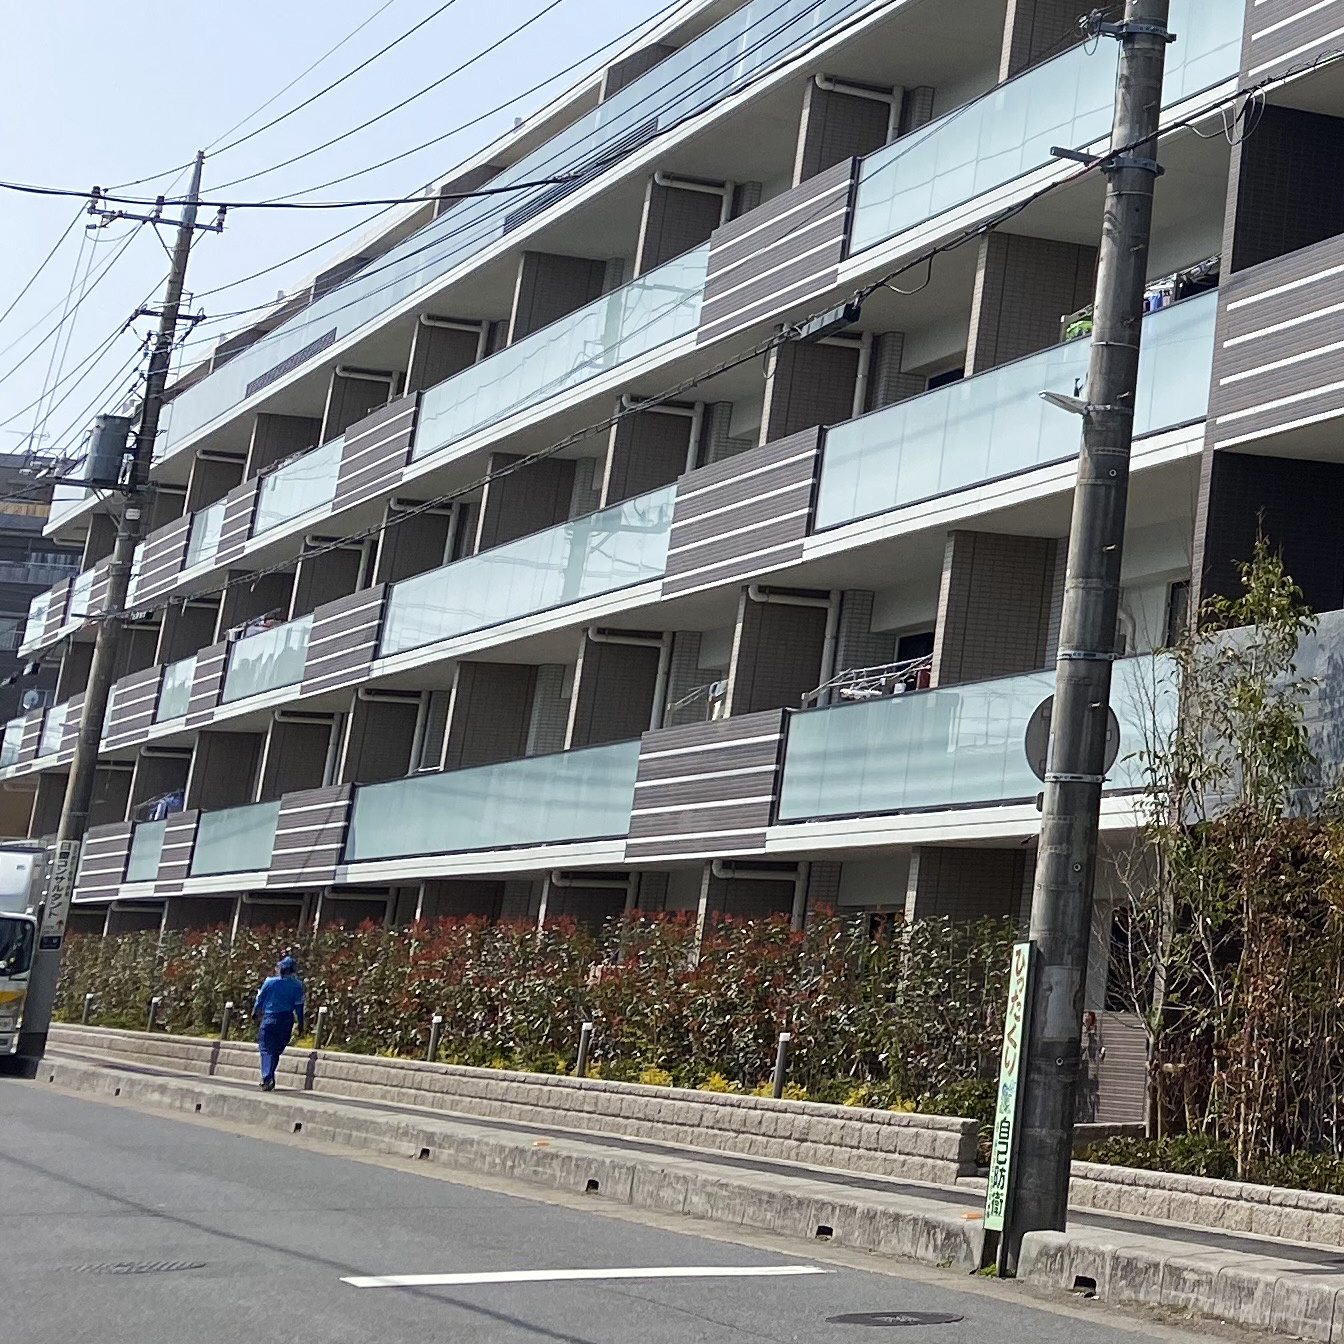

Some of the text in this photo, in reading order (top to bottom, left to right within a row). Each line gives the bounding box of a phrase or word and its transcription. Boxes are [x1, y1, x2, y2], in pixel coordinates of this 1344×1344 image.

[1004, 948, 1026, 1077] ひったくり
